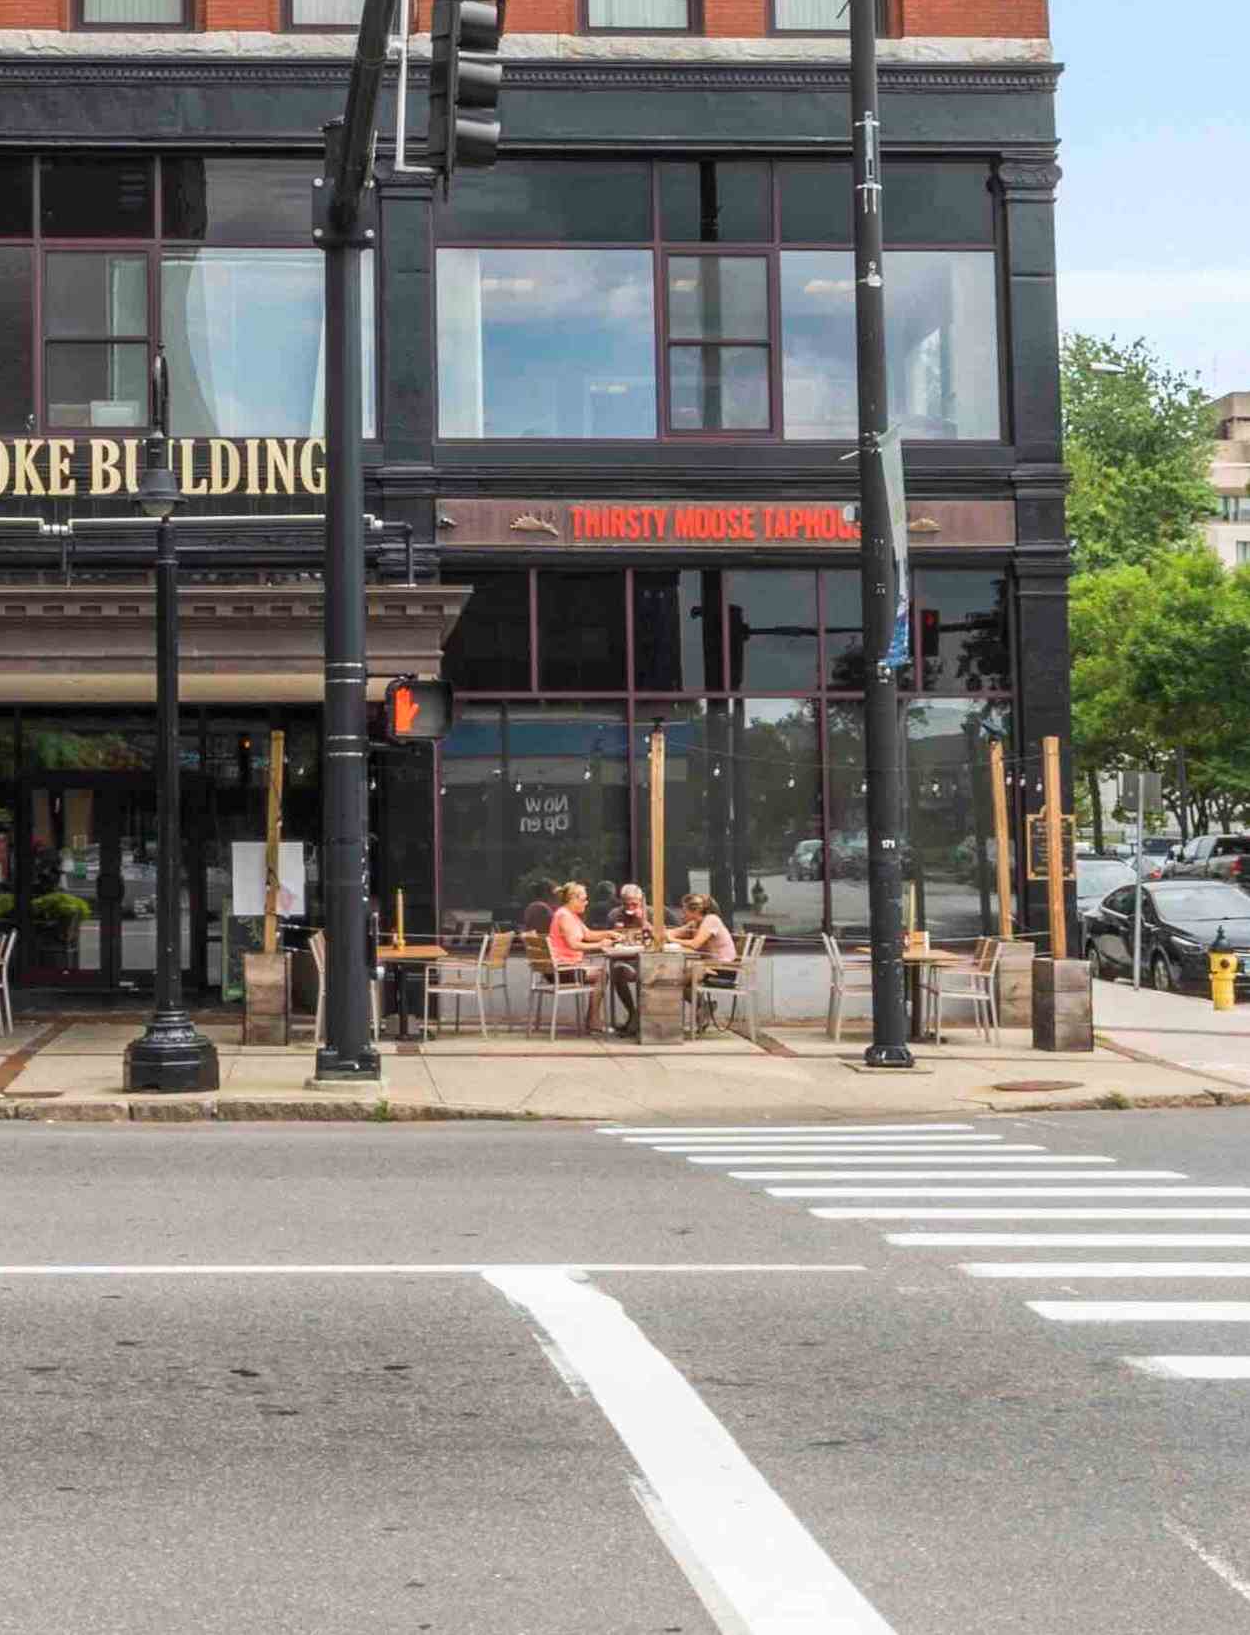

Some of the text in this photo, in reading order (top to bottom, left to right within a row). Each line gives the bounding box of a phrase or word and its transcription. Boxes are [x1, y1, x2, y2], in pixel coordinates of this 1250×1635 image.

[89, 437, 327, 495] BULDING
[570, 506, 862, 541] THIRSTY MOOSE TAPHOU
